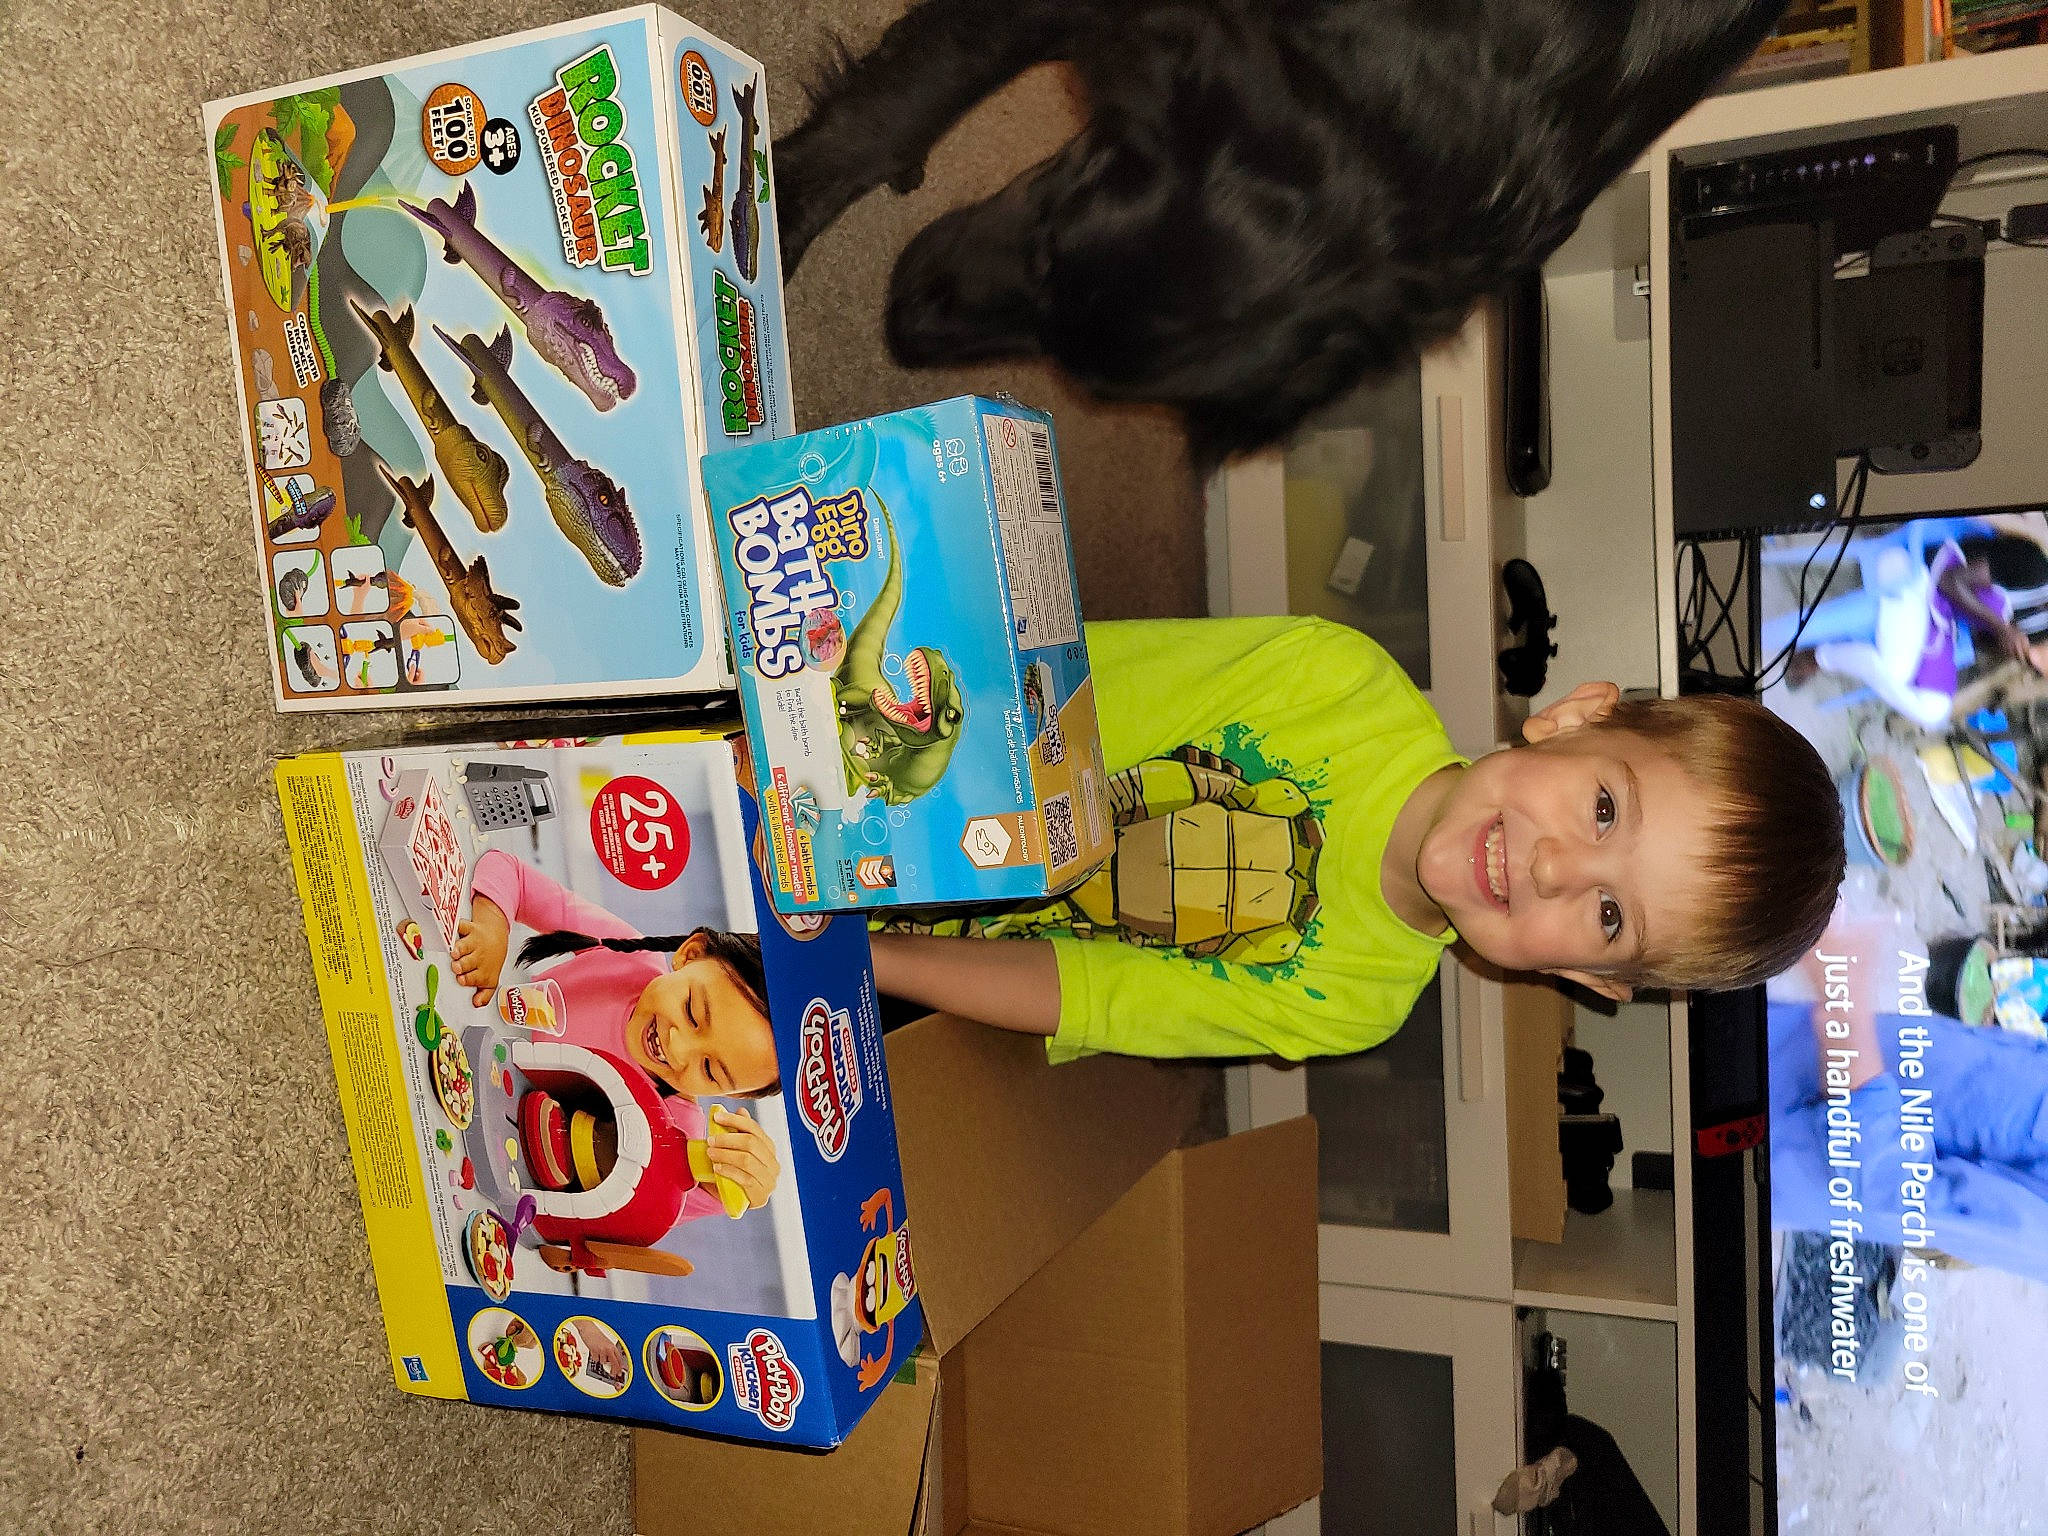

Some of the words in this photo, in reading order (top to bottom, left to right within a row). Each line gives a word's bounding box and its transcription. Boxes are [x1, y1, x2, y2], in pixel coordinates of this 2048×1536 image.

[692, 64, 706, 110] 100
[704, 81, 712, 112] FEET
[430, 109, 445, 147] FEET
[443, 99, 468, 160] 100
[464, 98, 474, 128] SOARS
[468, 130, 475, 142] UP
[469, 144, 476, 157] TO
[484, 128, 504, 166] 3+
[505, 127, 516, 158] AGES
[538, 89, 597, 264] DINOSAUR
[560, 50, 649, 272] ROCKET
[530, 106, 542, 126] KID
[536, 129, 560, 185] POWERED
[554, 189, 570, 236] ROCKET
[565, 240, 576, 262] SET
[285, 322, 306, 387] LAUNCHER!
[294, 328, 308, 372] ROCKET
[298, 314, 311, 352] COMES
[306, 354, 318, 380] WITH
[714, 271, 749, 432] ROCKET
[739, 299, 760, 422] DINOSAUR
[933, 440, 944, 468] ages
[938, 471, 946, 483] 6+
[811, 504, 844, 560] Egg
[836, 495, 865, 556] Dino
[735, 611, 746, 630] for
[740, 632, 754, 658] kids
[776, 690, 786, 712] inside!
[785, 690, 792, 698] to
[786, 698, 795, 712] find
[789, 714, 798, 725] the
[790, 726, 799, 741] dino
[799, 720, 808, 736] bath
[1004, 710, 1014, 738] Bombes
[802, 736, 812, 756] bomb
[1006, 739, 1016, 748] de
[1008, 750, 1018, 765] bain
[778, 781, 790, 824] different
[1010, 766, 1024, 804] dinosaures
[767, 795, 778, 815] with
[620, 790, 674, 879] 25+
[772, 822, 787, 864] illustrated
[782, 825, 797, 863] dinosaur
[1017, 816, 1029, 862] PALEONTOLOGY
[800, 842, 811, 864] bath
[778, 866, 789, 889] cards
[790, 865, 804, 897] models
[802, 866, 816, 896] bombs
[1816, 950, 1857, 1011] just
[1898, 950, 1932, 1015] And
[856, 1007, 866, 1040] Playset
[1826, 1020, 1850, 1039] a
[862, 1042, 870, 1063] Oven
[1898, 1026, 1934, 1078] the
[804, 1013, 842, 1154] Play-Doh
[1826, 1049, 1861, 1166] handful
[1900, 1089, 1934, 1151] Nile
[1829, 1178, 1863, 1211] of
[1901, 1162, 1936, 1247] Perch
[1904, 1259, 1936, 1281] is
[1830, 1219, 1864, 1381] freshwater
[1904, 1292, 1929, 1350] one
[756, 1336, 791, 1422] Play-Doh
[1904, 1361, 1939, 1395] of
